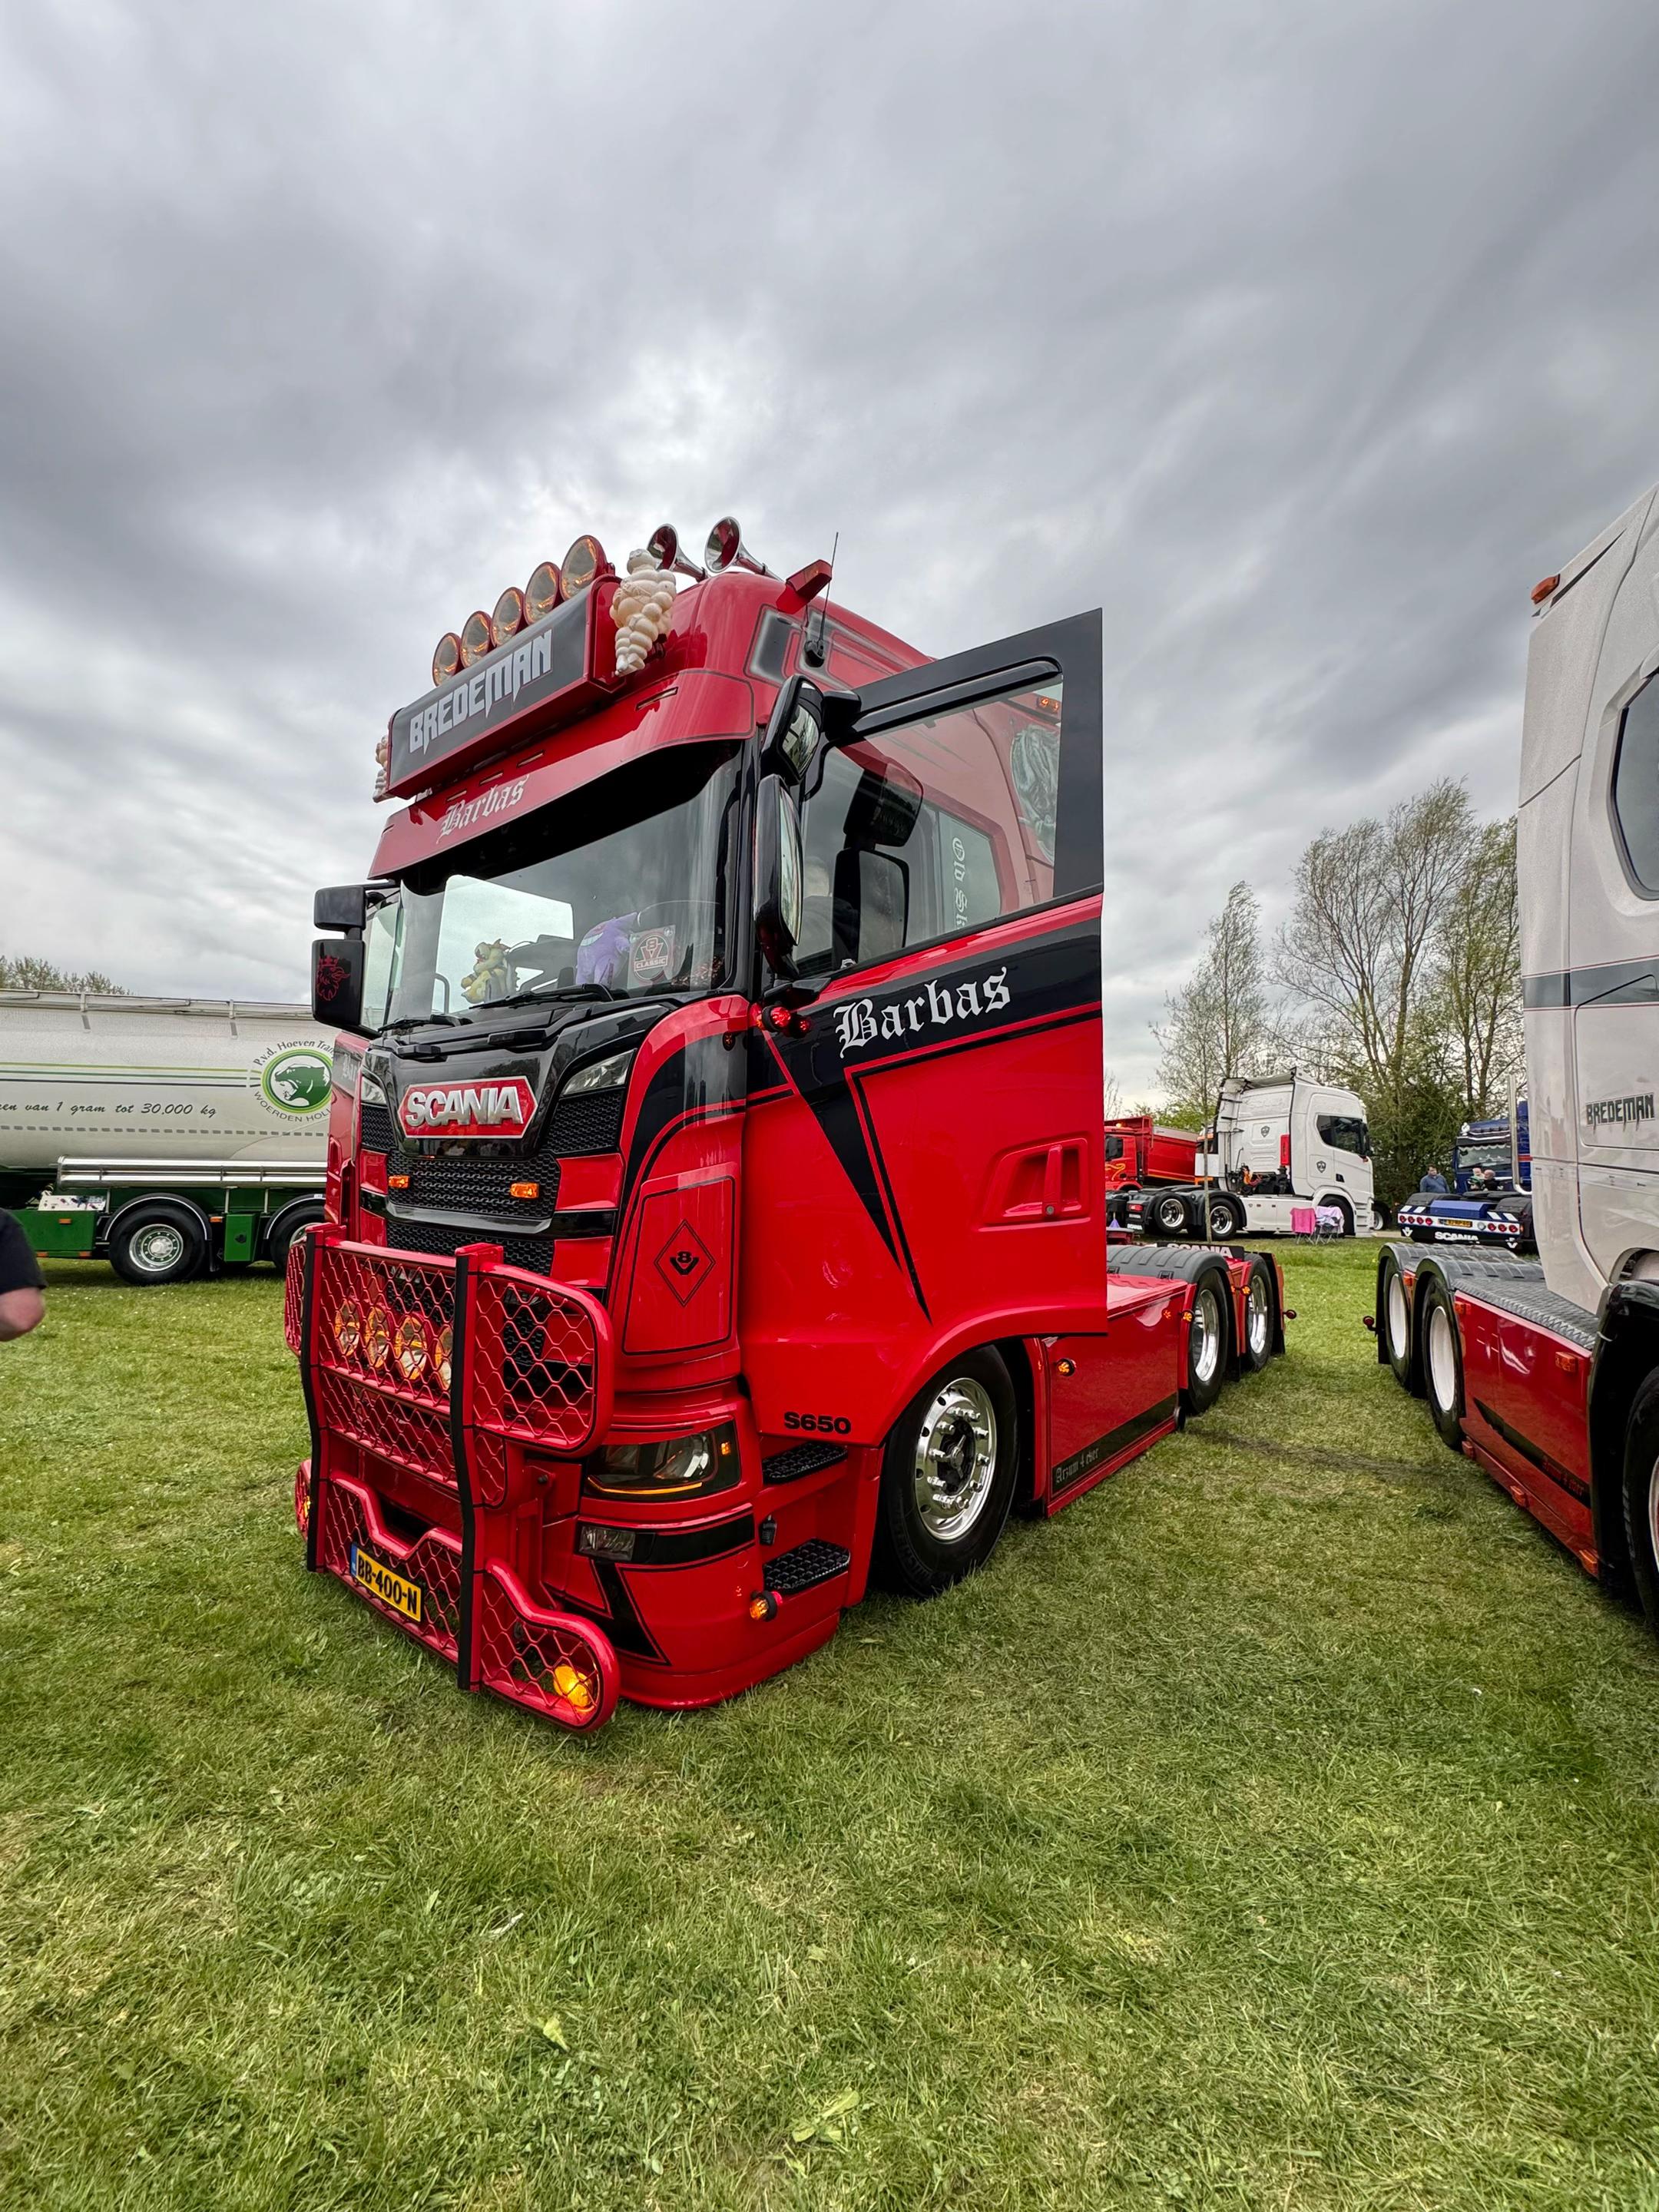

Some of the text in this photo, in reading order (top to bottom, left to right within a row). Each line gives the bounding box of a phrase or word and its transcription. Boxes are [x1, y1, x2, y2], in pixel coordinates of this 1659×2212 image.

[409, 628, 552, 756] BREDEMAN
[436, 773, 530, 844] Barbas
[833, 966, 1011, 1058] Barbas
[277, 1040, 315, 1051] Hoeven
[70, 1104, 105, 1115] gram
[115, 1104, 134, 1113] tot
[200, 1104, 217, 1118] kg
[253, 1091, 303, 1122] WOERDEN
[405, 1085, 525, 1127] SCANIA
[1586, 1094, 1654, 1134] BREDEMAN
[784, 1412, 852, 1435] S650
[358, 1554, 418, 1615] BB-400-N
